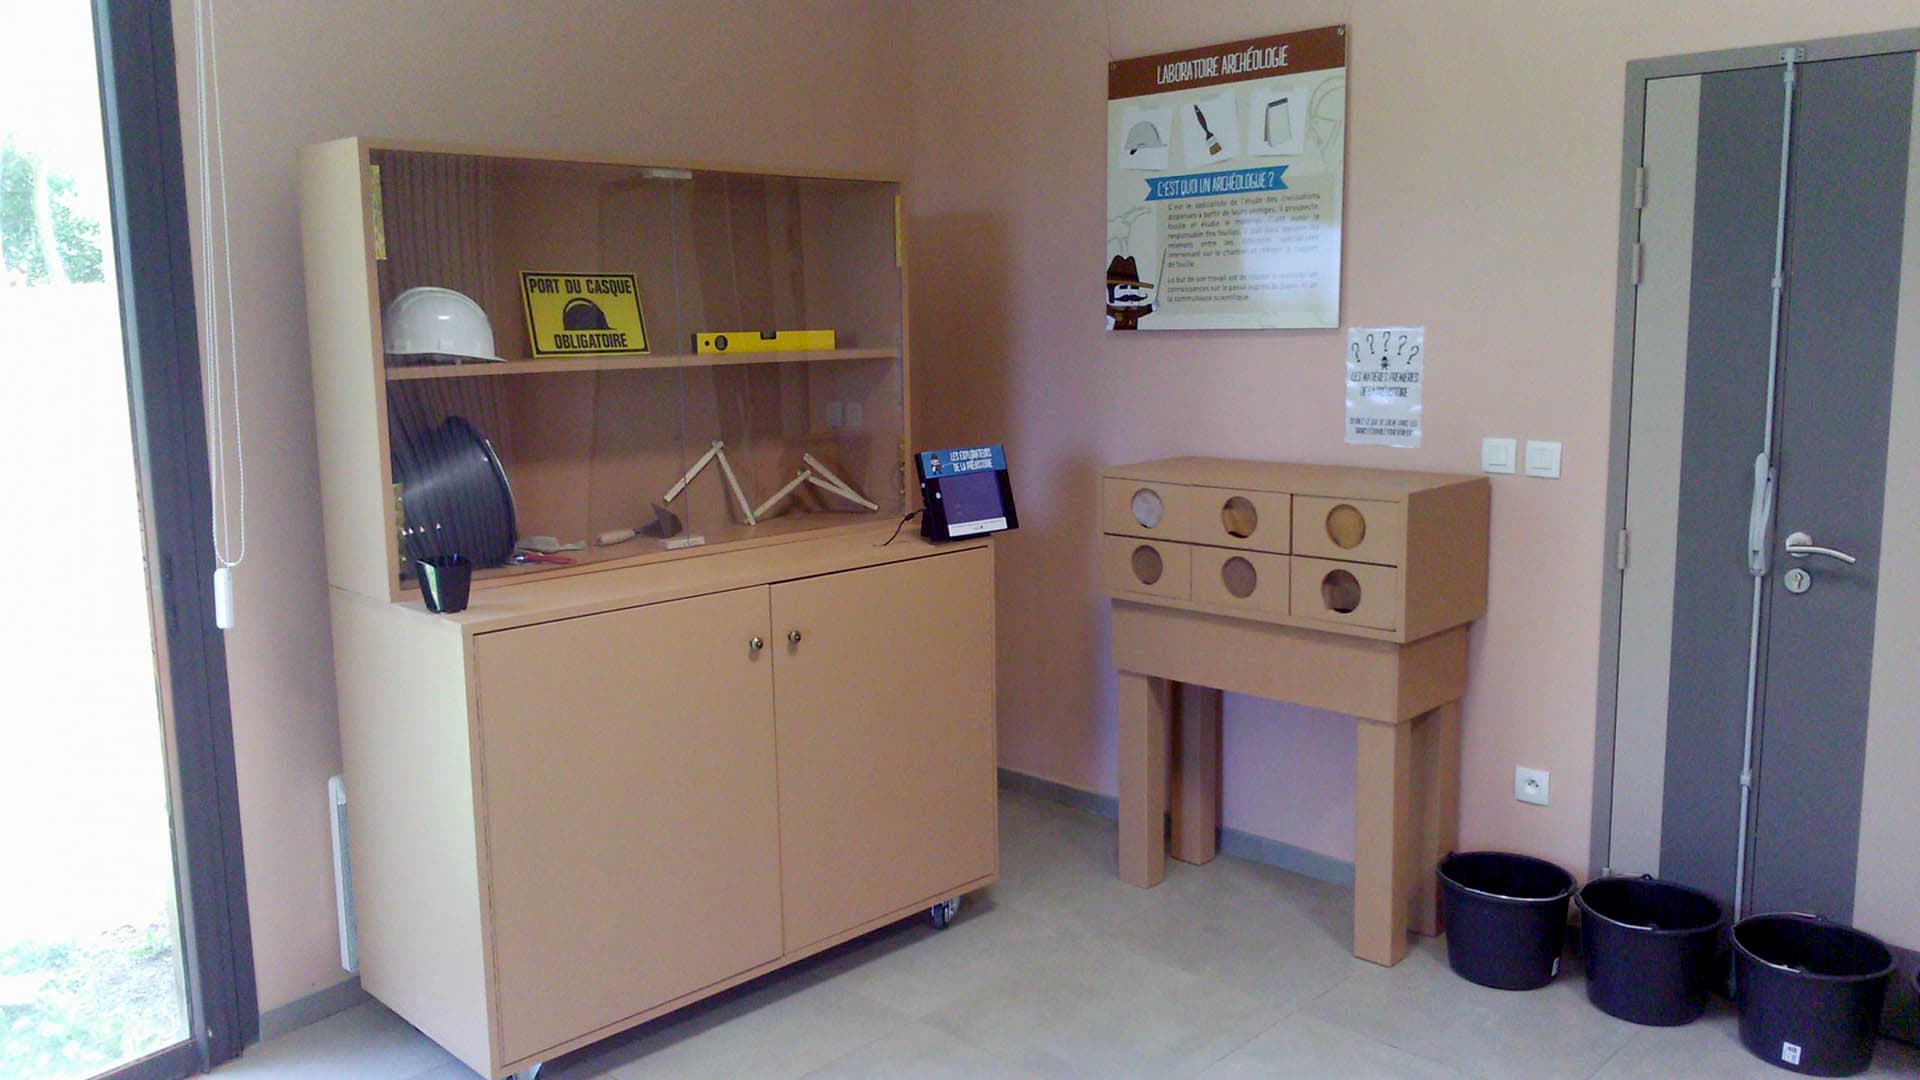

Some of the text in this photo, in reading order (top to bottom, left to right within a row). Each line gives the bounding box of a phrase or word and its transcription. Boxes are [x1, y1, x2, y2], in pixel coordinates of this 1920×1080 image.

[1157, 44, 1288, 85] LABORATOIRE ARCHÉOLOGIE
[1157, 171, 1275, 197] C'EST QUOI UN ARCHÉOLOGUE ?
[528, 277, 632, 297] PORT DU CASQUE
[554, 332, 628, 350] OBLIGATOIRE
